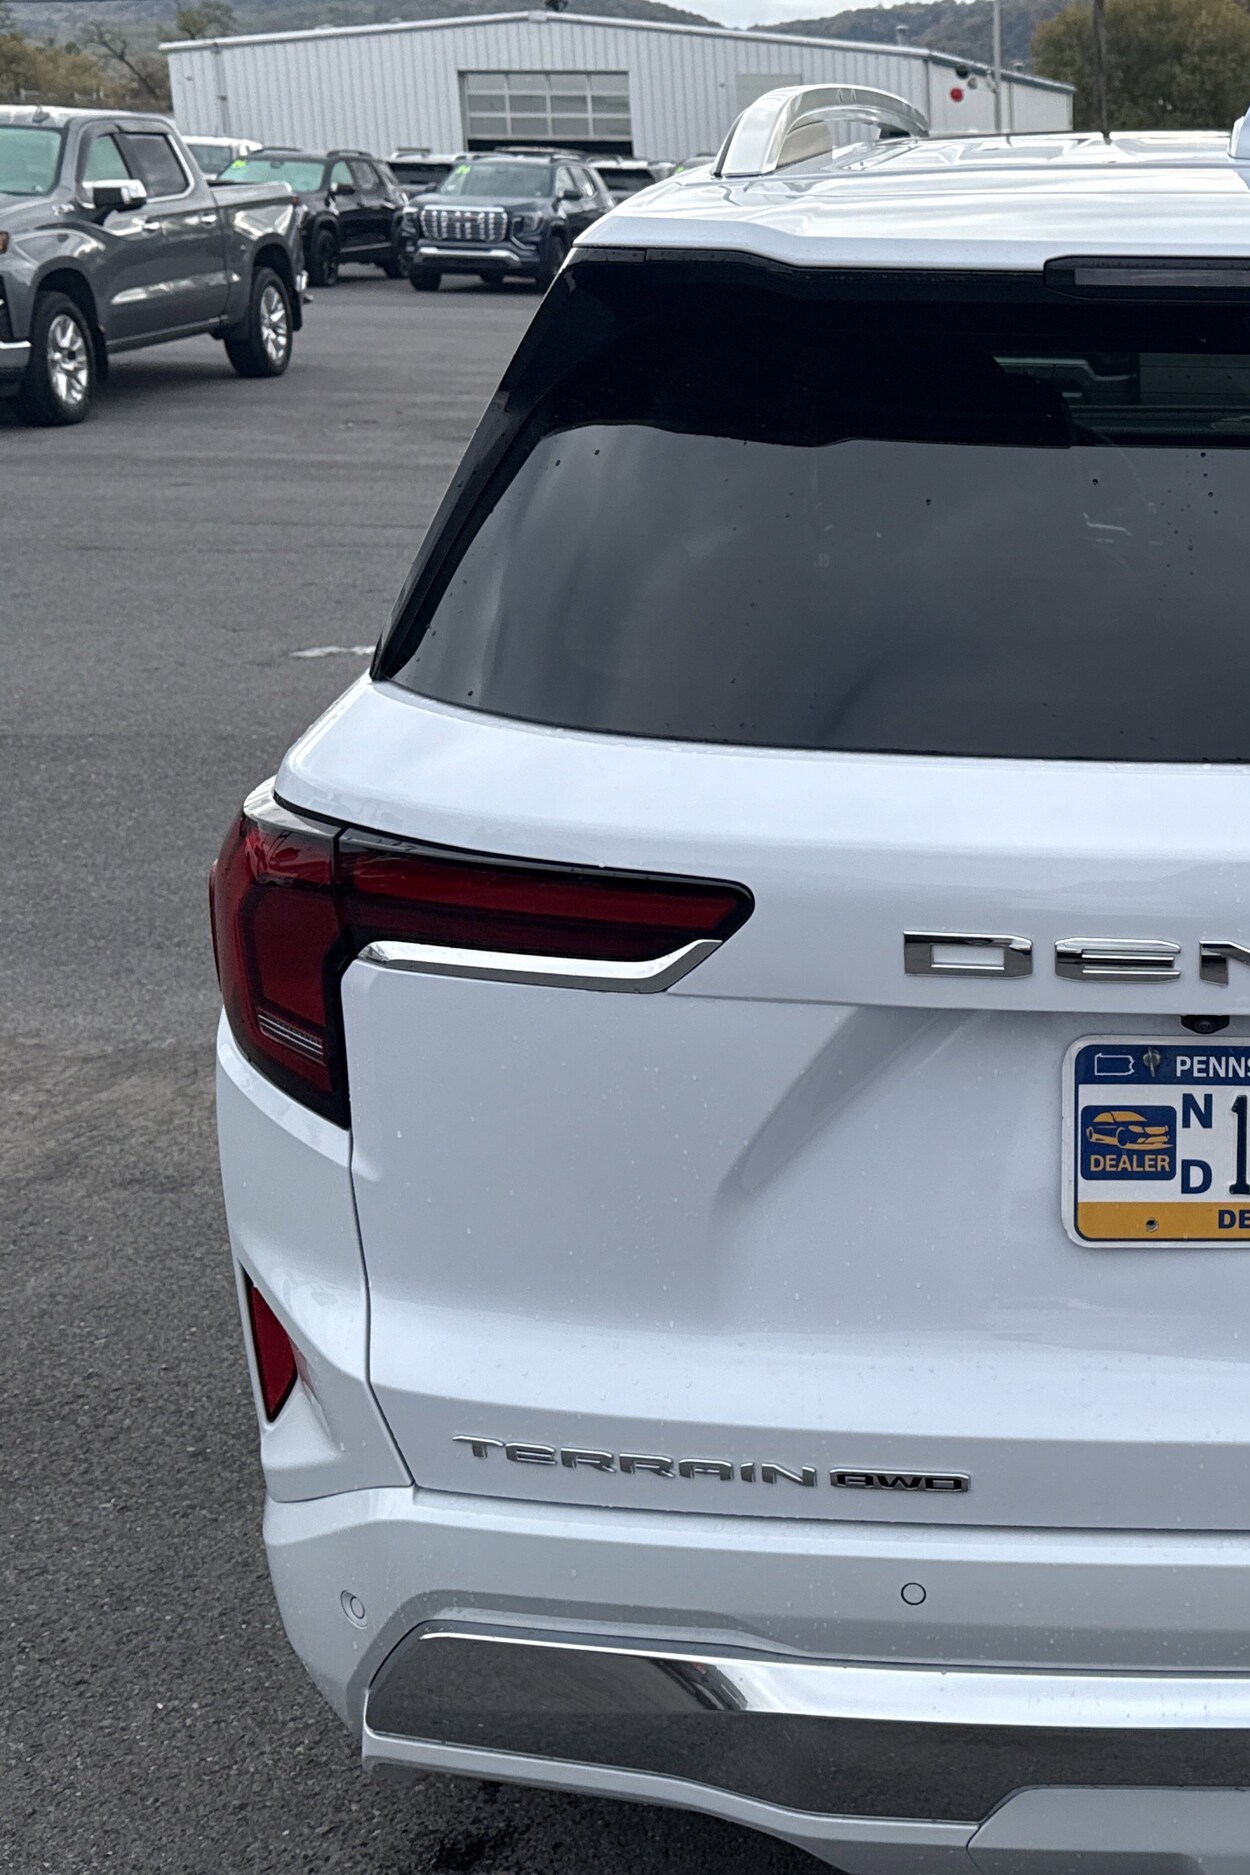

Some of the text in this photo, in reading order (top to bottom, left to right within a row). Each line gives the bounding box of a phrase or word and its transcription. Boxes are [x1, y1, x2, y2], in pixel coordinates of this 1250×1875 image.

[1089, 1154, 1171, 1173] DEALER
[452, 1434, 965, 1492] TERRAIN AWD
